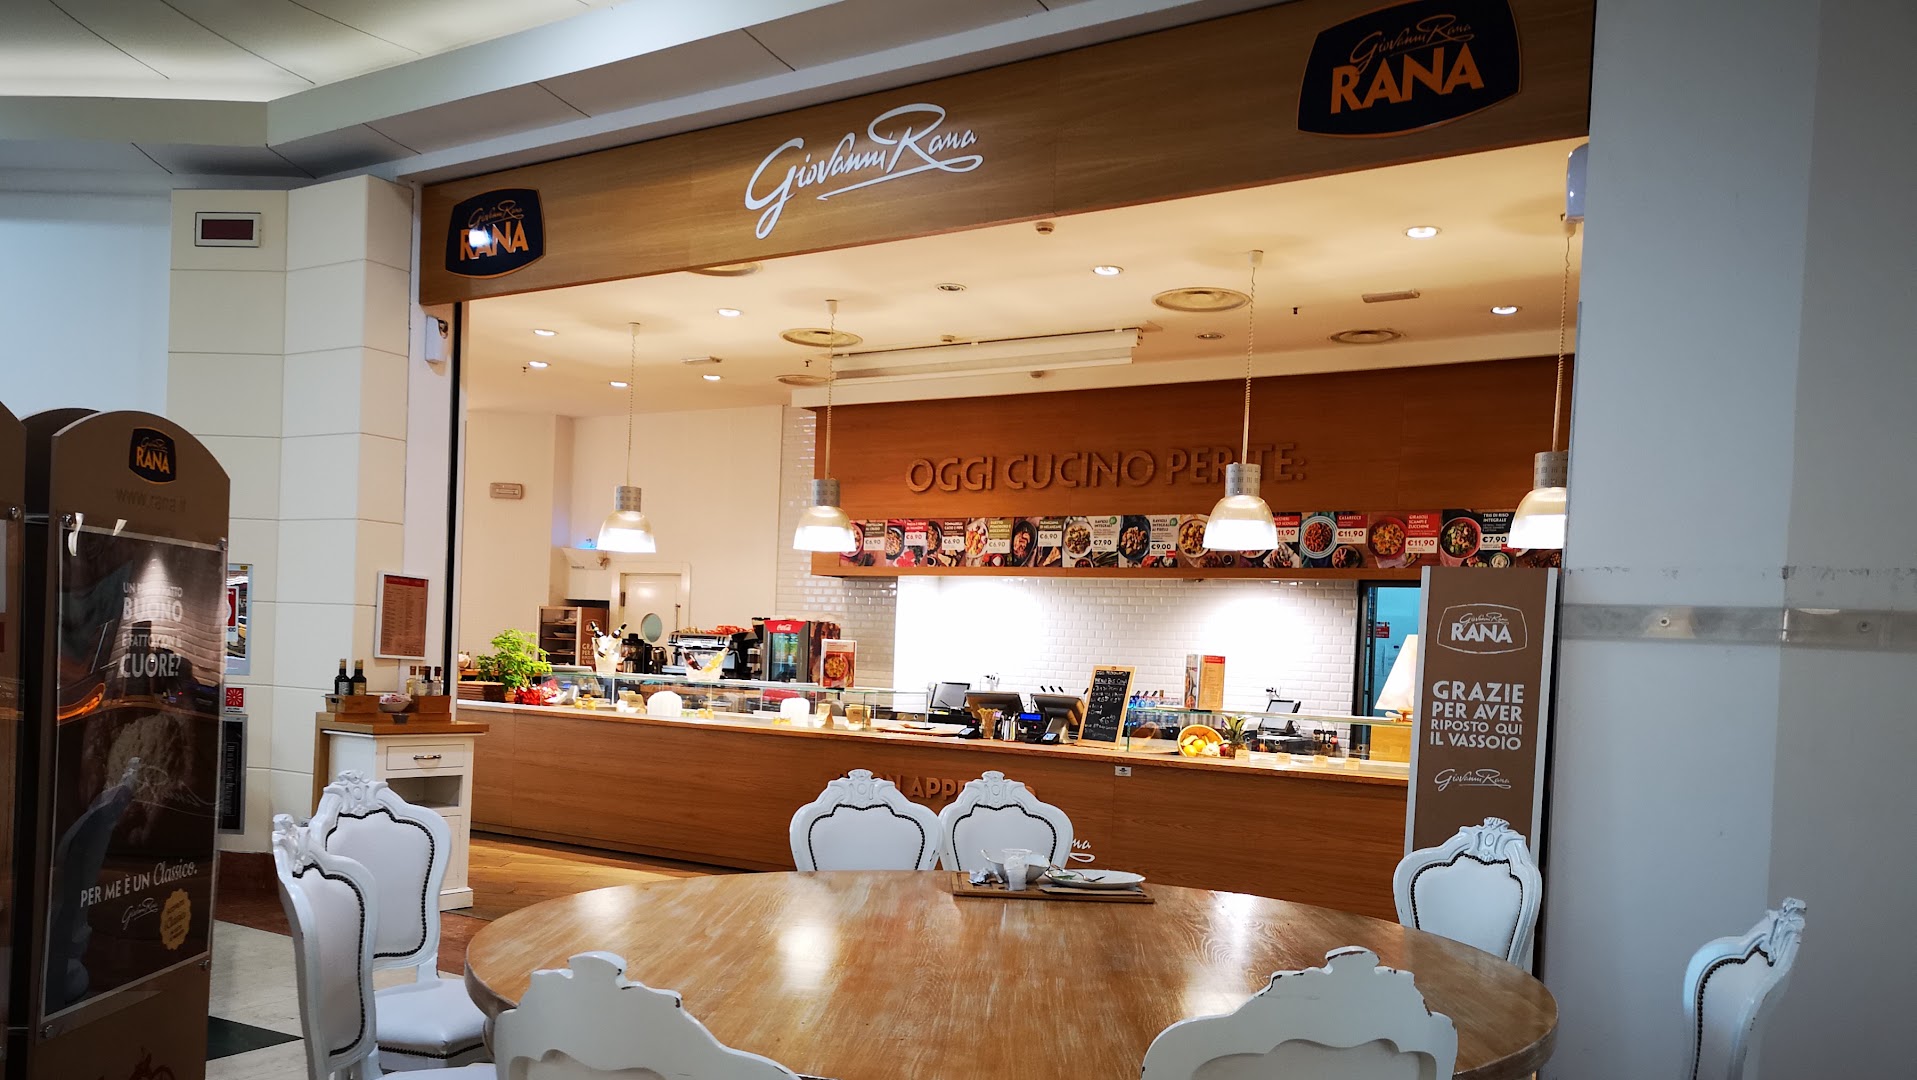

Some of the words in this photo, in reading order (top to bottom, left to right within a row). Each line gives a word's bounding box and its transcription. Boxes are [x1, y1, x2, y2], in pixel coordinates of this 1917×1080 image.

[1350, 28, 1427, 76] Giovanni
[1331, 43, 1484, 114] RANA
[744, 132, 887, 240] Giovanni
[867, 103, 984, 174] Rana
[136, 446, 170, 474] RANA
[906, 455, 995, 492] OGGI
[1002, 450, 1157, 490] CUCINO
[1407, 539, 1435, 547] €11,90
[1451, 622, 1513, 644] RANA
[119, 652, 181, 678] CUORE?
[1432, 680, 1525, 704] GRAZIE
[1432, 702, 1467, 719] PER
[1473, 704, 1523, 722] AVER
[1430, 731, 1444, 746] IL
[1448, 733, 1521, 750] VASSOIO
[1431, 719, 1489, 733] RIPOSTO
[1495, 723, 1523, 736] QUI
[80, 886, 102, 908] PER
[104, 880, 121, 900] ME
[124, 874, 131, 895] È
[133, 872, 150, 892] UN
[153, 858, 198, 886] Classico.
